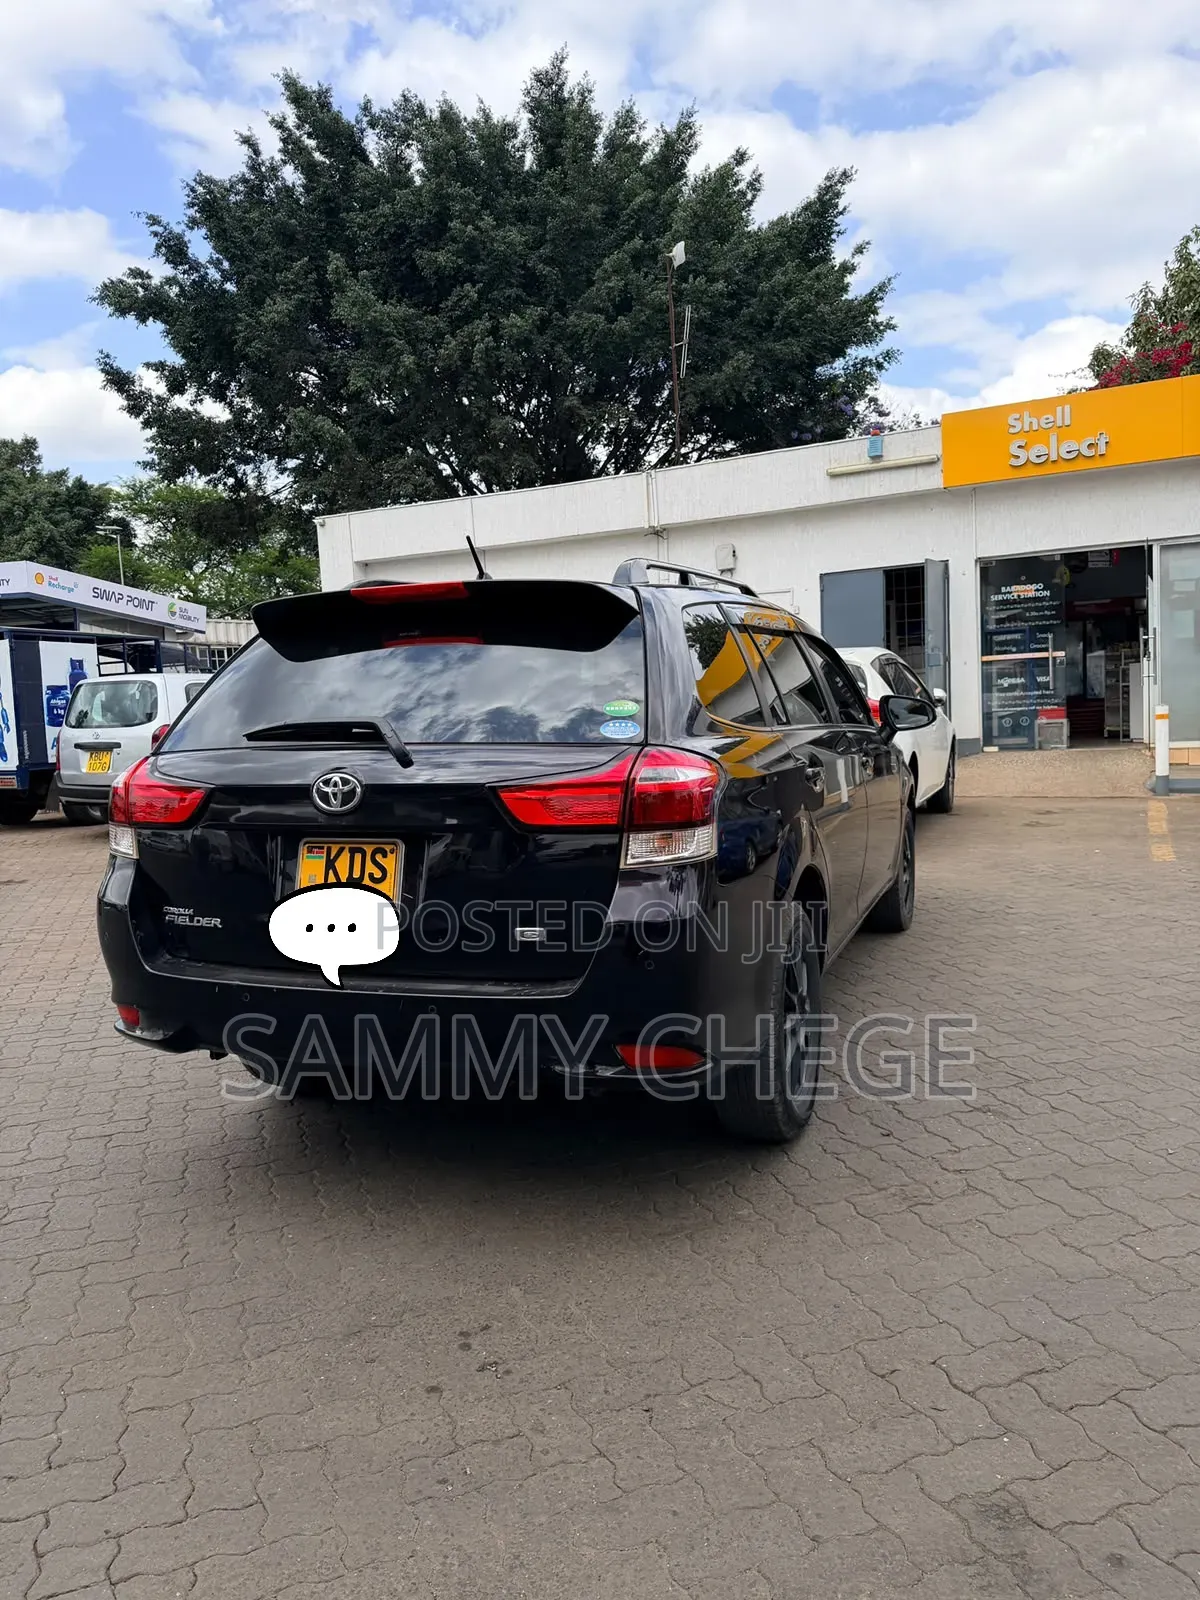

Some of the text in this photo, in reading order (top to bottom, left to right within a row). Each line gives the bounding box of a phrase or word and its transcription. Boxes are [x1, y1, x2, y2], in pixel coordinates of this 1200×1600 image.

[1007, 404, 1071, 434] Shell
[1008, 431, 1110, 467] Select
[0, 578, 10, 586] TY
[48, 580, 75, 593] Recharge
[92, 586, 155, 611] SWAP POINT
[990, 590, 1050, 601] SERVICE STATION
[90, 751, 105, 761] KBU
[88, 762, 107, 771] 107G
[323, 845, 389, 885] KDS
[165, 914, 222, 928] FIELDER
